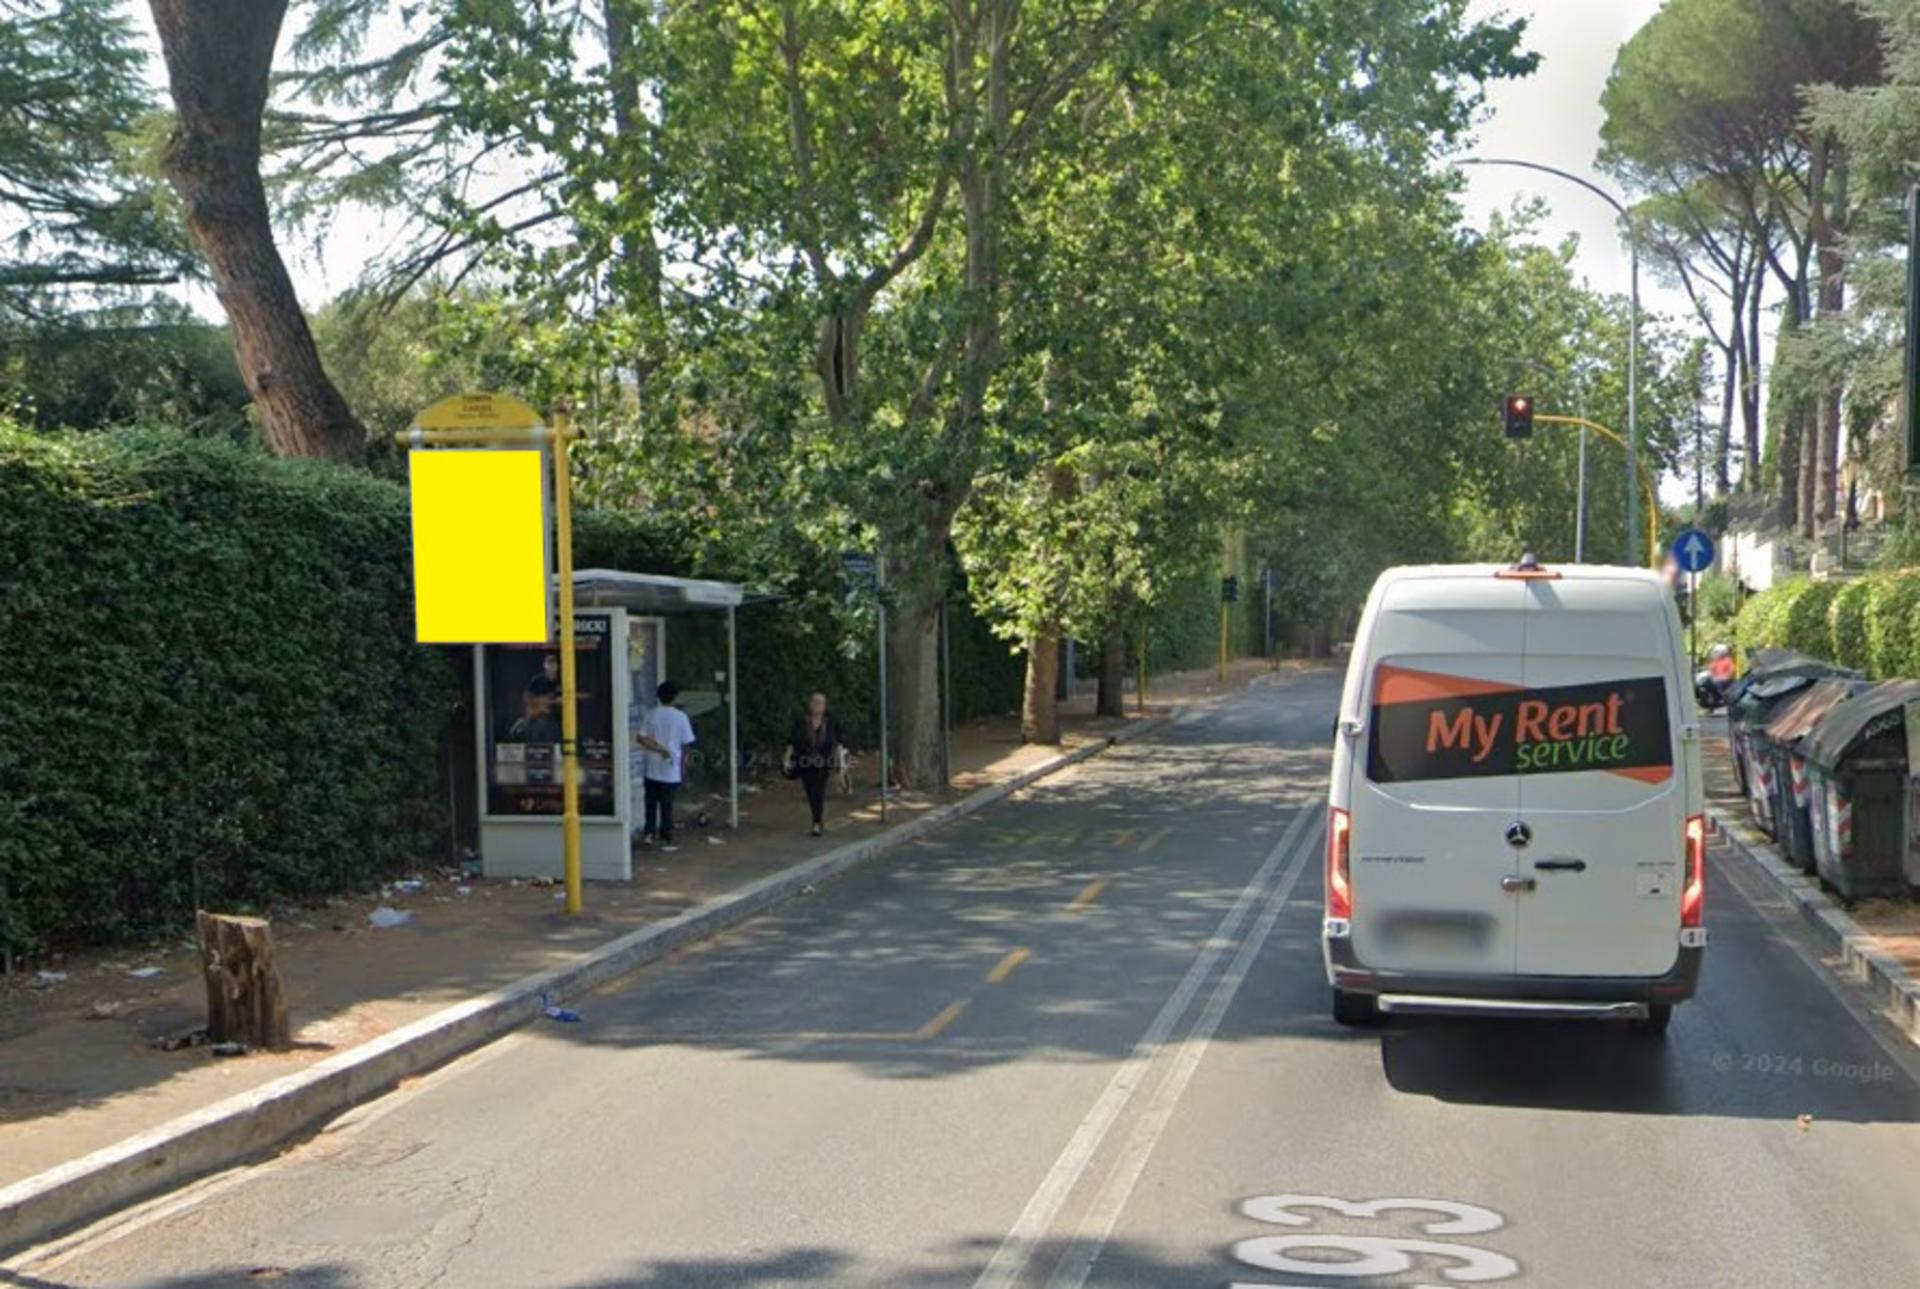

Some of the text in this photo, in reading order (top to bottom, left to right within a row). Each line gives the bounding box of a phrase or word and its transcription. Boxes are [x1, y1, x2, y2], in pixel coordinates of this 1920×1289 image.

[1426, 692, 1625, 763] My Rent
[1516, 732, 1630, 770] service
